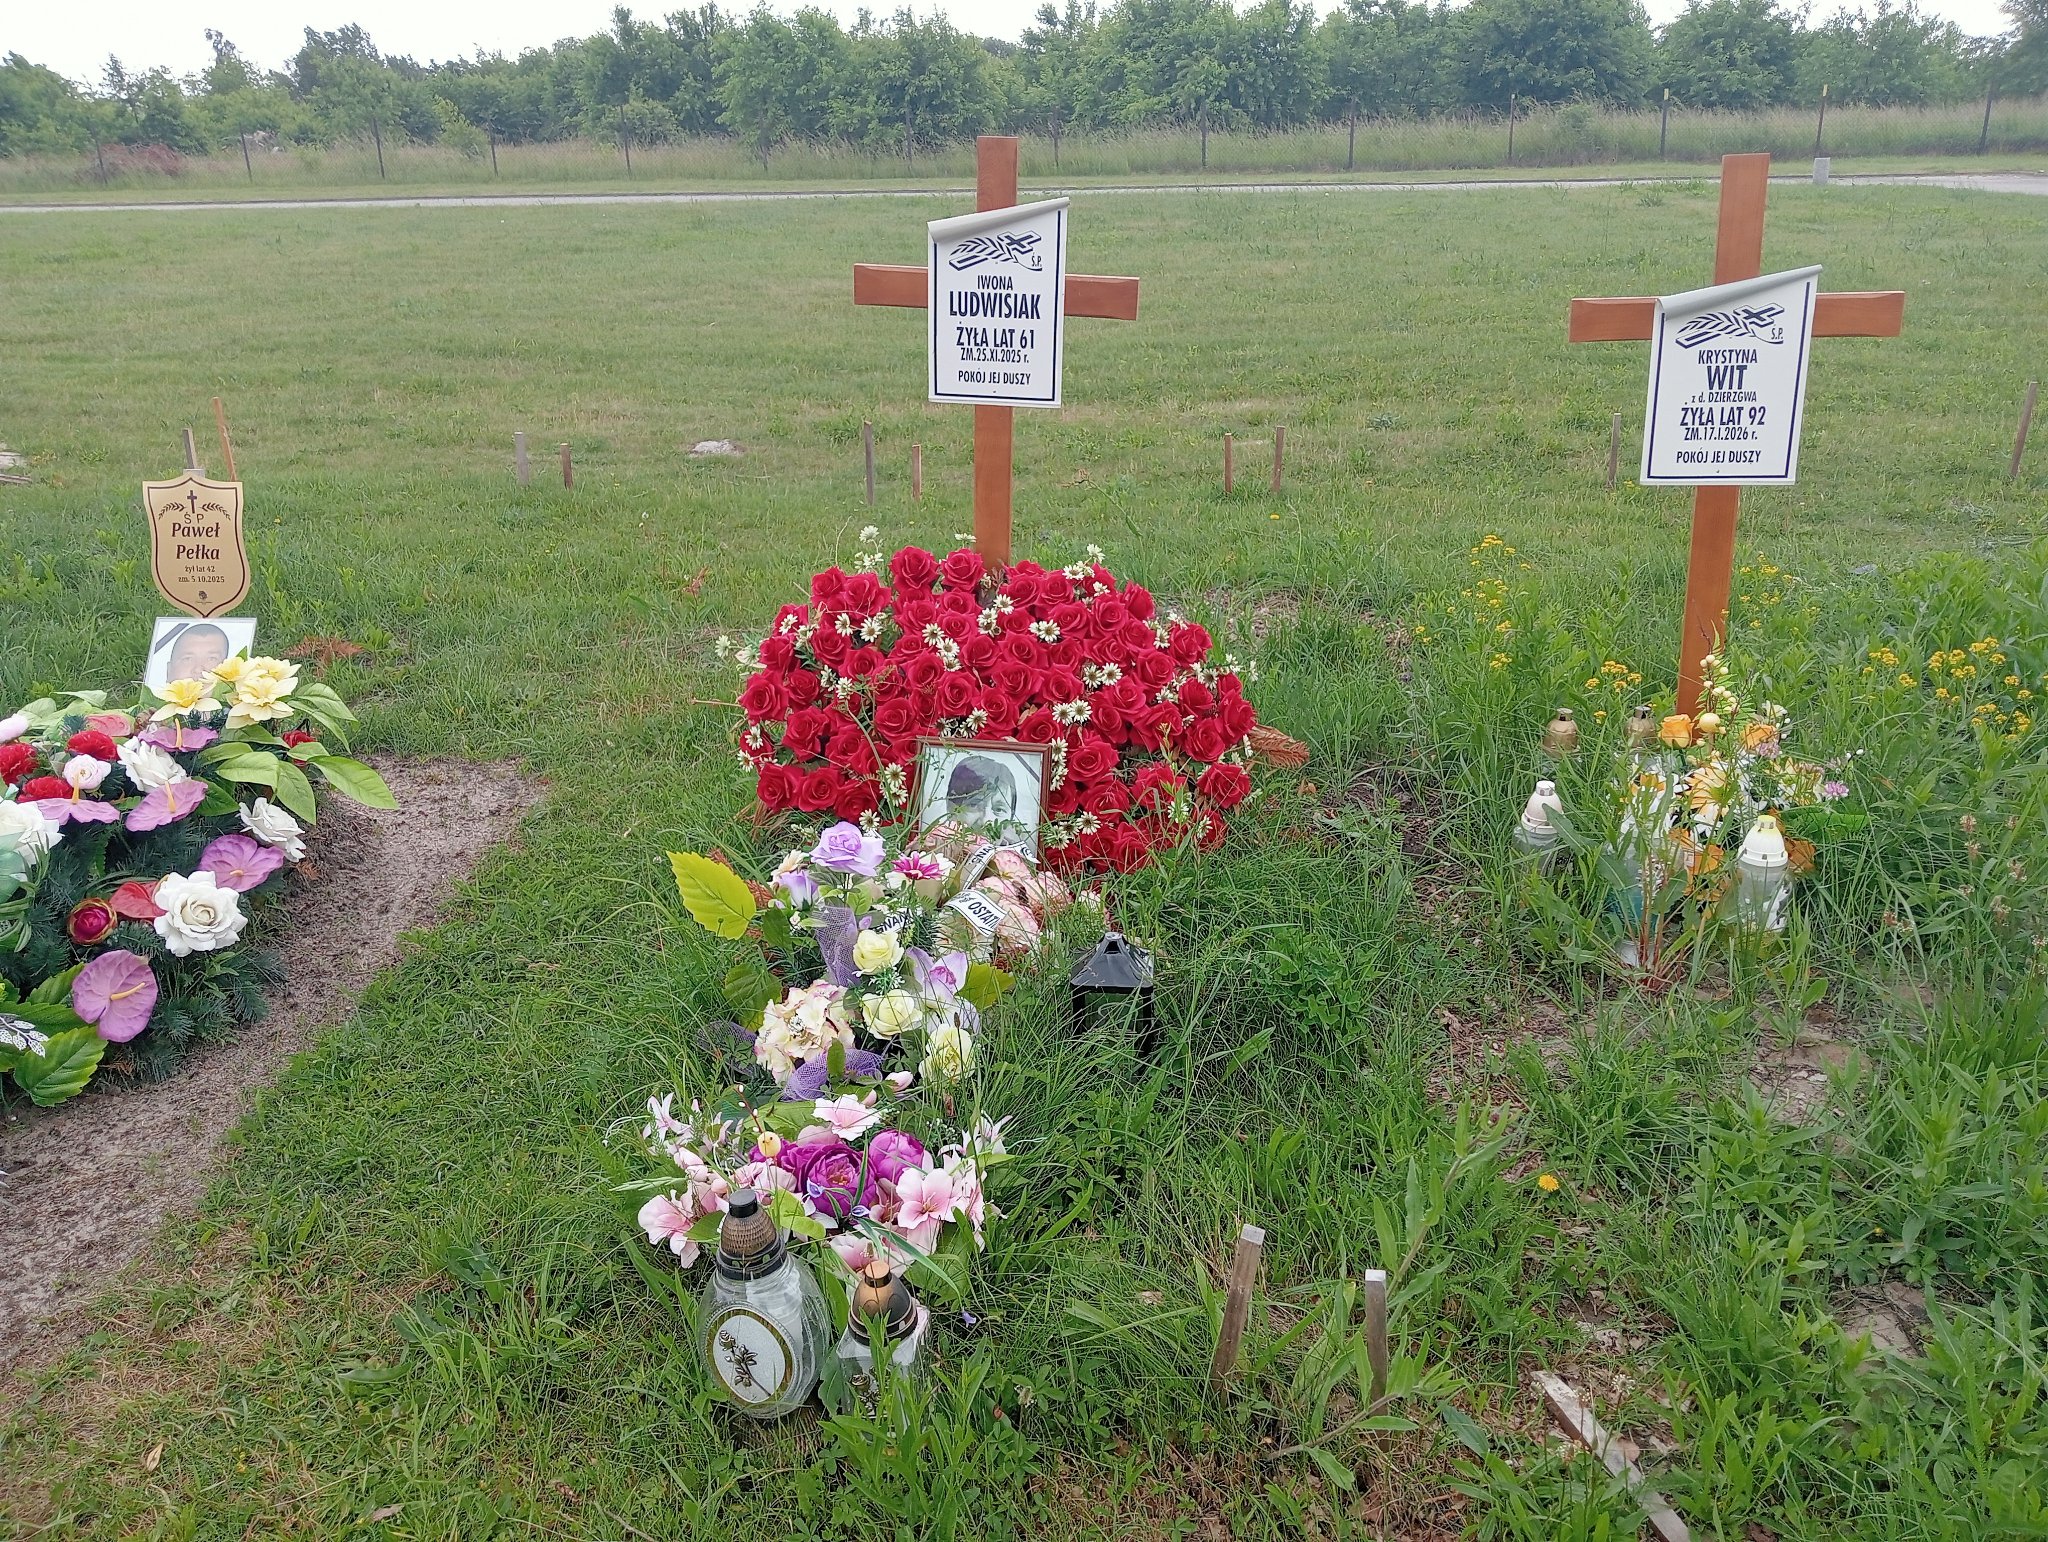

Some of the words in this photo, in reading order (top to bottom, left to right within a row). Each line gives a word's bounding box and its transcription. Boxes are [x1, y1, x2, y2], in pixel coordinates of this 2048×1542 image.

[977, 275, 1013, 290] IWONA
[950, 291, 1041, 319] LUDWISIAK
[956, 322, 989, 347] ŻYŁA
[994, 328, 1015, 348] LAT
[1020, 329, 1035, 349] 61
[961, 348, 1022, 363] ZM.25.XI.2025
[1024, 353, 1029, 363] r.
[1698, 349, 1757, 364] KRYSTYNA
[959, 368, 985, 383] POKÓJ
[988, 372, 1001, 384] JEJ
[1004, 373, 1031, 385] DUSZY
[1706, 365, 1747, 390] WIT
[1691, 395, 1695, 403] z
[1698, 392, 1706, 403] d.
[1708, 392, 1757, 403] DZIERZGWA
[1680, 402, 1714, 426] ŻYŁA
[1720, 407, 1744, 425] LAT
[1749, 406, 1766, 425] 92
[1684, 427, 1748, 441] ZM.17.I.2026
[1751, 431, 1758, 440] r.
[1676, 447, 1708, 463] POKÓJ
[1711, 452, 1725, 463] JEJ
[1729, 451, 1761, 463] DUSZY
[197, 514, 204, 523] P
[172, 522, 220, 537] Paweł
[176, 545, 220, 559] Pełka
[185, 565, 194, 574] żył
